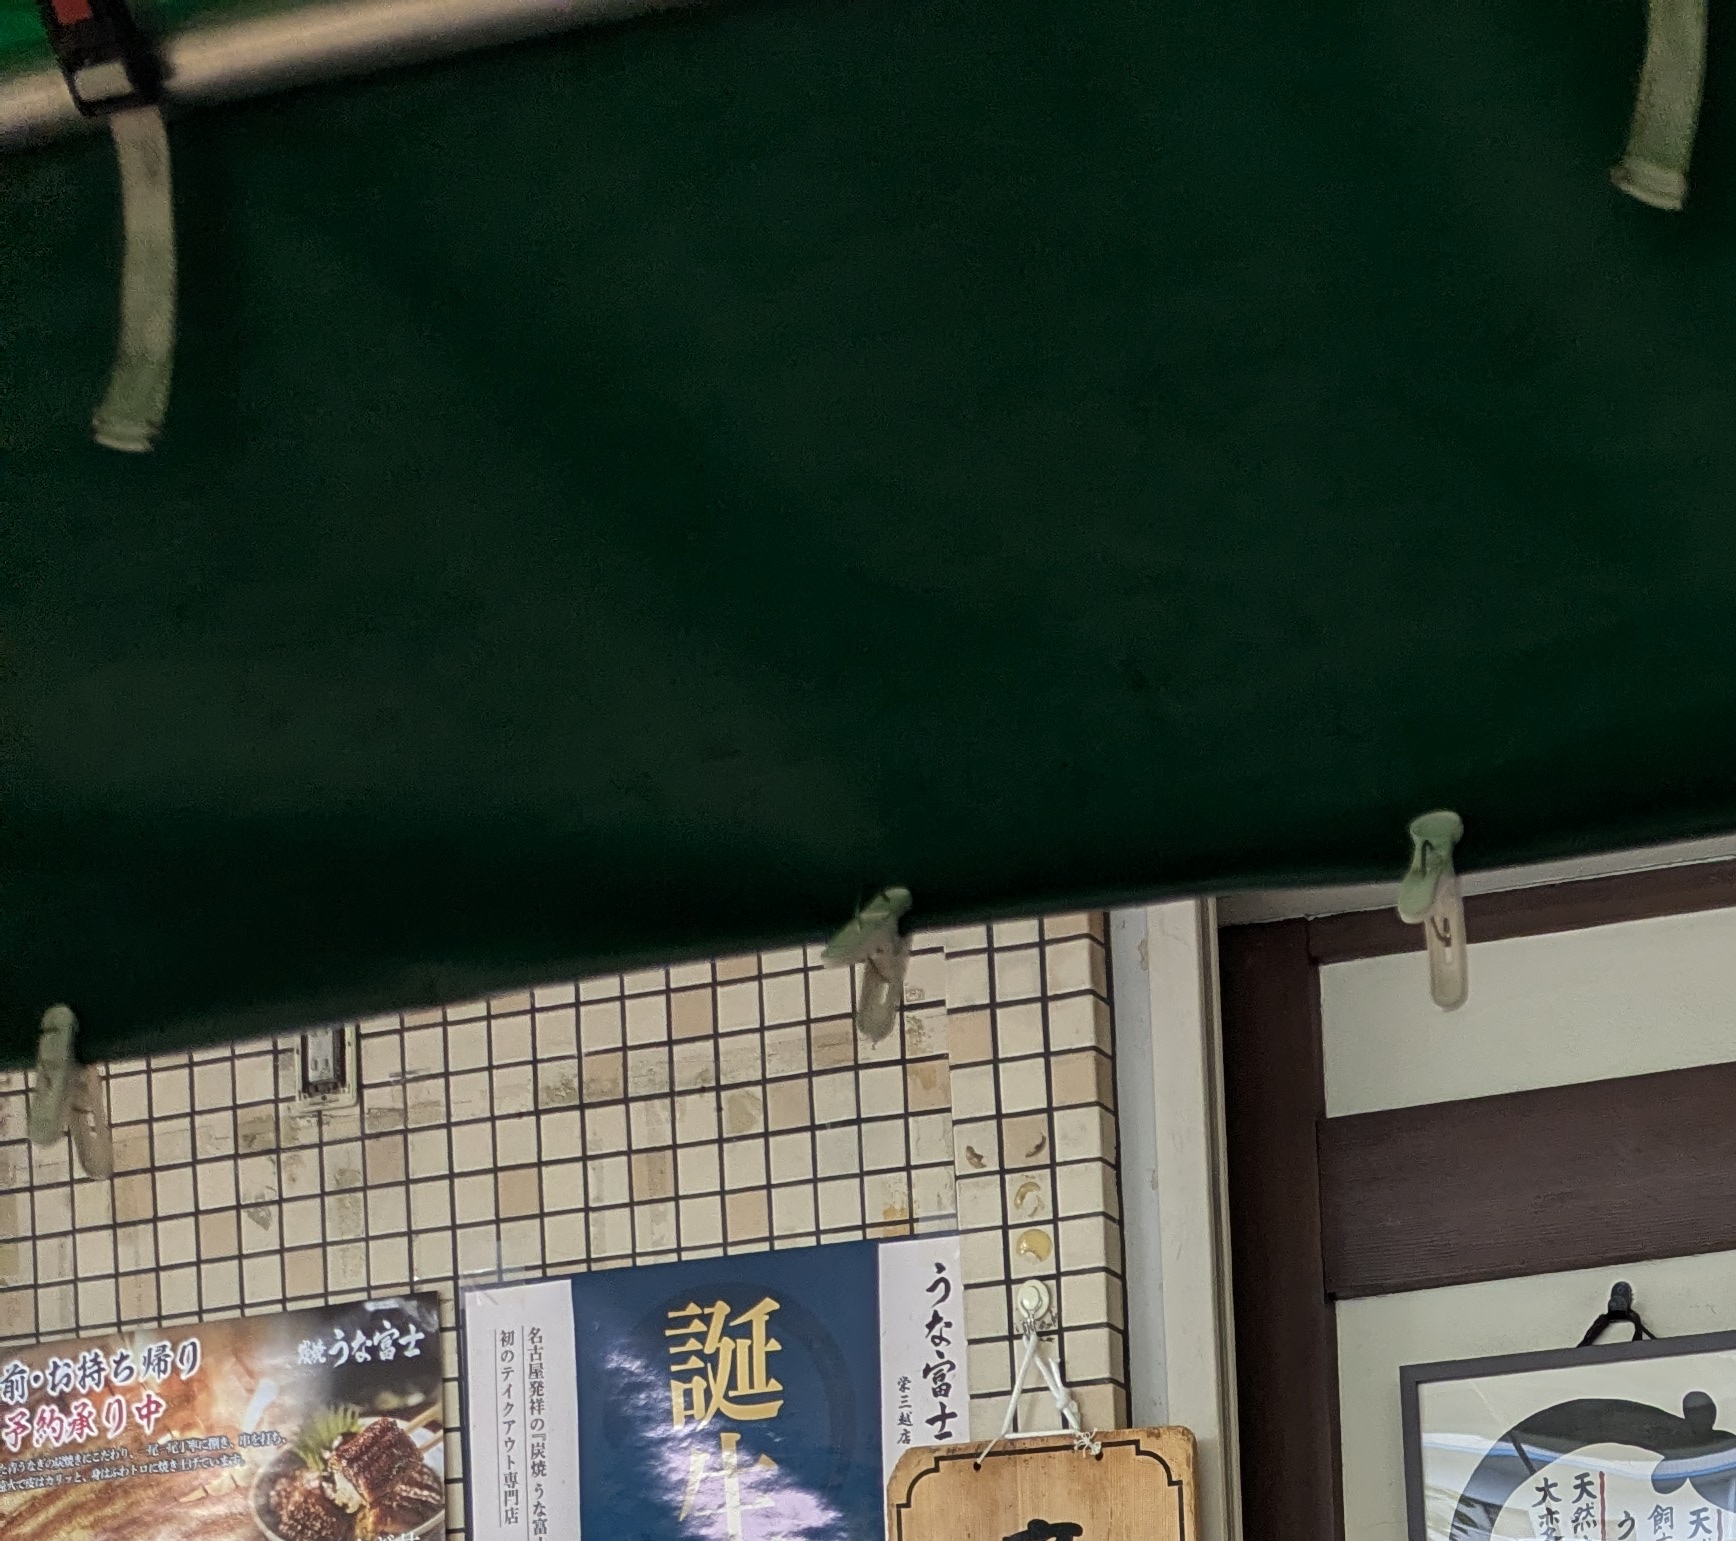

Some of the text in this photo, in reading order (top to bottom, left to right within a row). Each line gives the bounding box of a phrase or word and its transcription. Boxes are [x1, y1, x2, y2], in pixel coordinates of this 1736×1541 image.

[328, 1320, 425, 1368] うな富士
[921, 1263, 958, 1441] うな富士
[3, 1393, 168, 1453] 予約承り中
[499, 1329, 519, 1525] 初のテイクアウト専門店
[896, 1376, 912, 1446] 栄三越店
